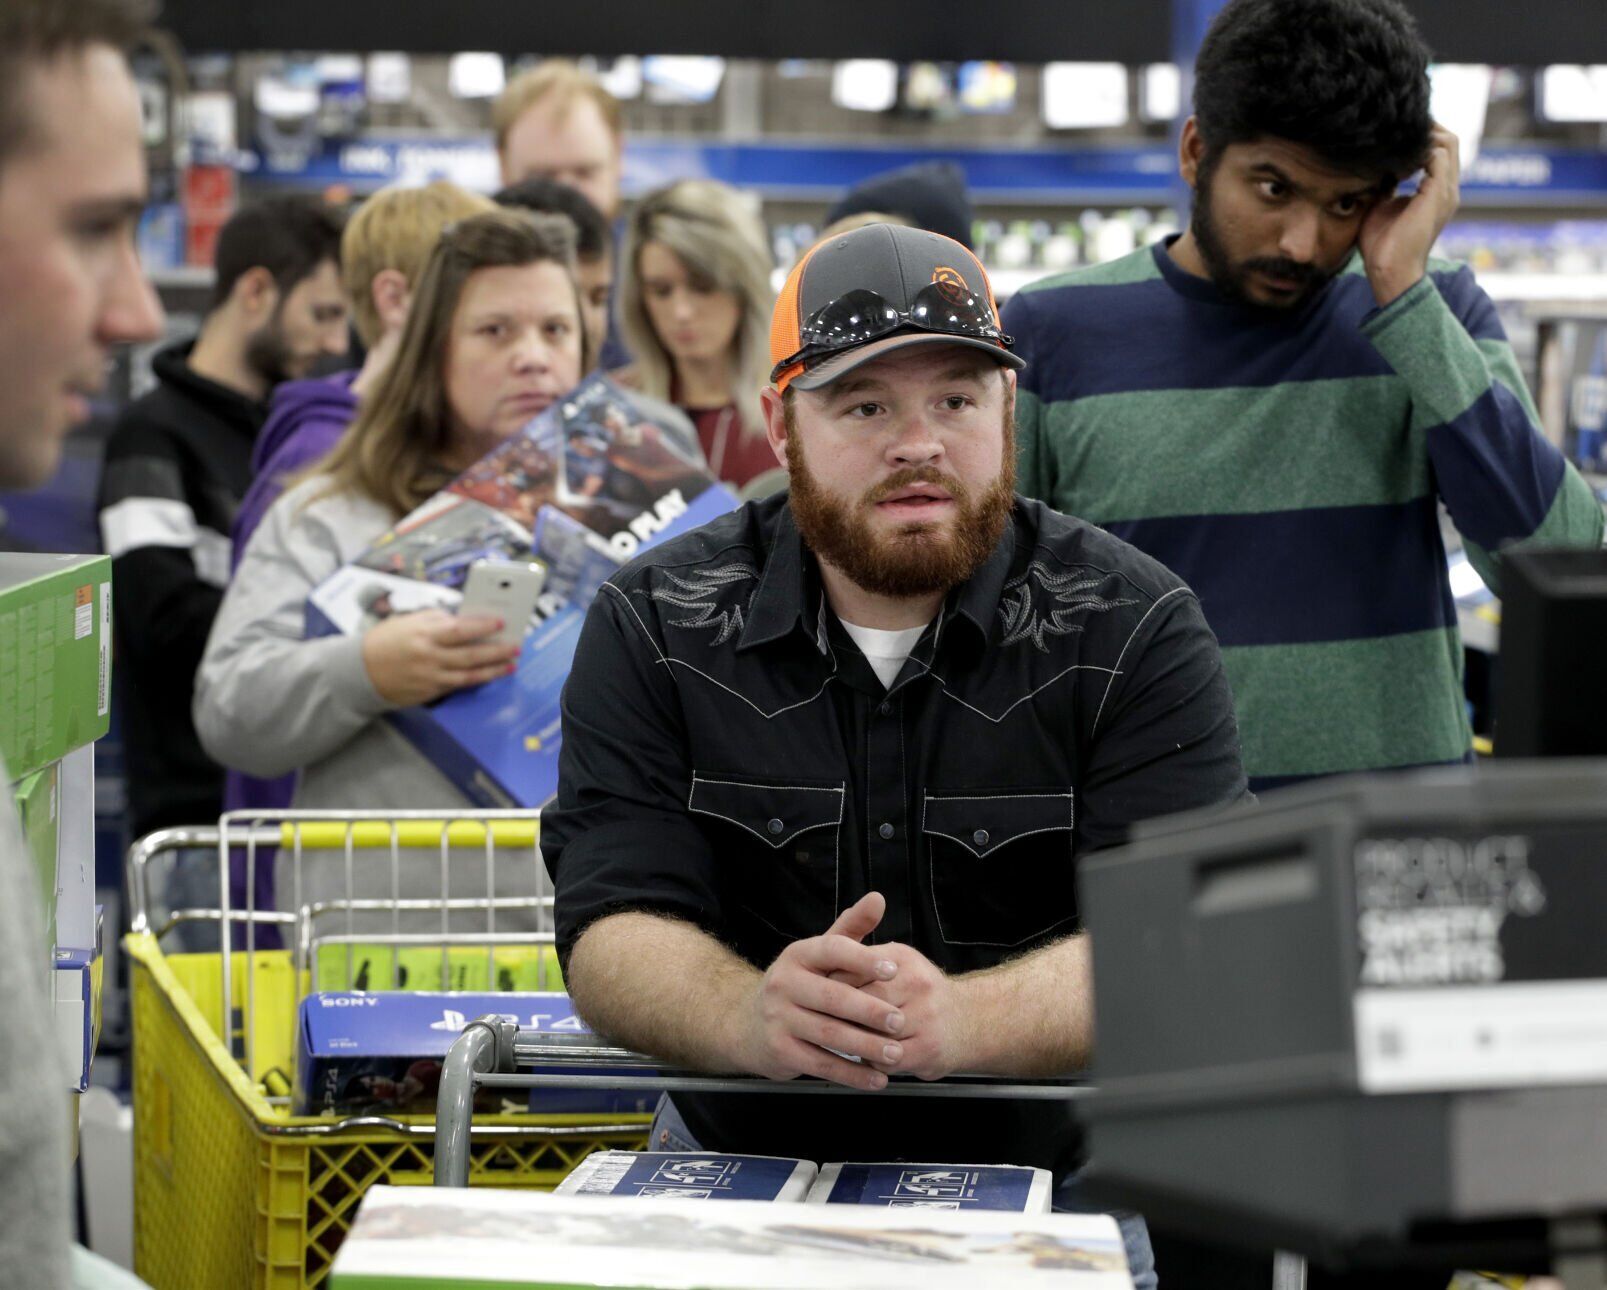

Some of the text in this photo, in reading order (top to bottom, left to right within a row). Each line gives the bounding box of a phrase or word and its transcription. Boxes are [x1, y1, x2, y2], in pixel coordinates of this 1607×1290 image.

[628, 487, 688, 542] PLAY
[1357, 838, 1530, 880] PRODUCT
[1360, 909, 1502, 947] SAFETY
[322, 997, 378, 1007] SONY
[323, 1068, 338, 1105] PS4
